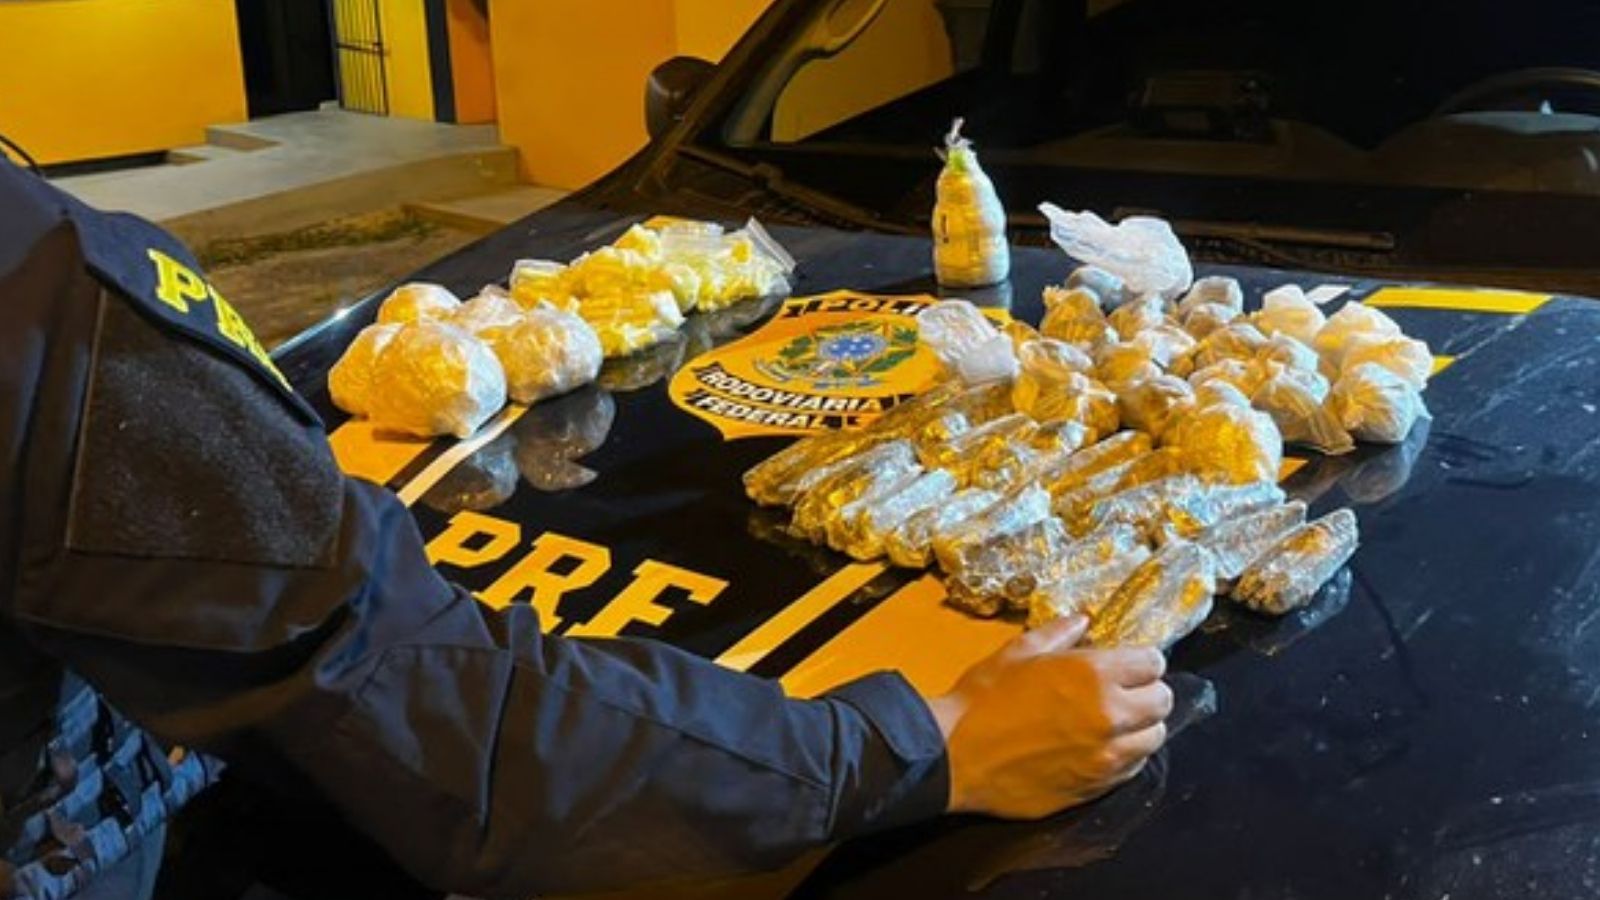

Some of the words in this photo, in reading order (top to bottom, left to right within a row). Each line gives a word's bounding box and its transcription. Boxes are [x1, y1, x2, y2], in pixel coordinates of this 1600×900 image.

[147, 248, 293, 393] PR
[817, 296, 922, 316] POLI
[695, 395, 829, 428] FEDERAL
[424, 510, 730, 637] PRF
